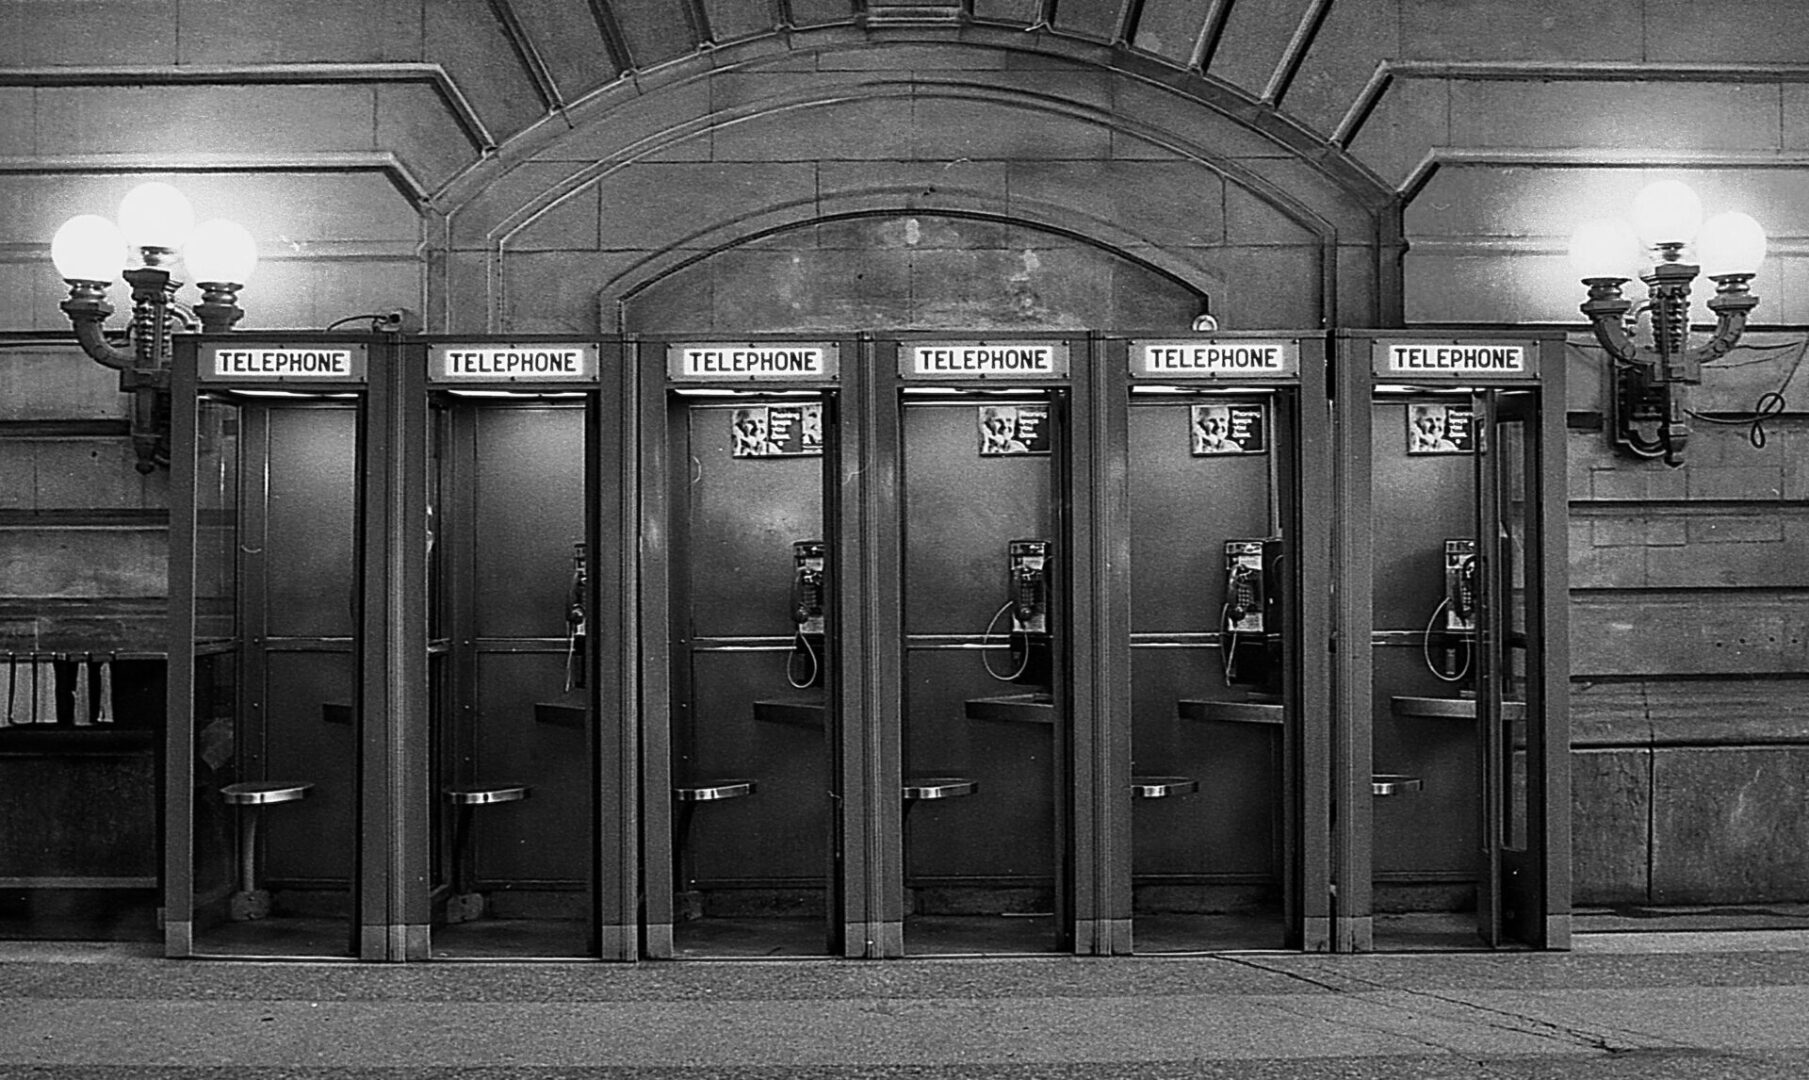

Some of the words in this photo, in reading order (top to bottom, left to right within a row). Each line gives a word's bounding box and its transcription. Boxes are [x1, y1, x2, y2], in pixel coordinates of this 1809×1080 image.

[219, 352, 345, 372] TELEPHONE
[450, 353, 576, 372] TELEPHONE
[689, 352, 817, 371] TELEPHONE
[920, 350, 1048, 369] TELEPHONE
[1151, 349, 1277, 368] TELEPHONE
[1394, 348, 1519, 368] TELEPHONE
